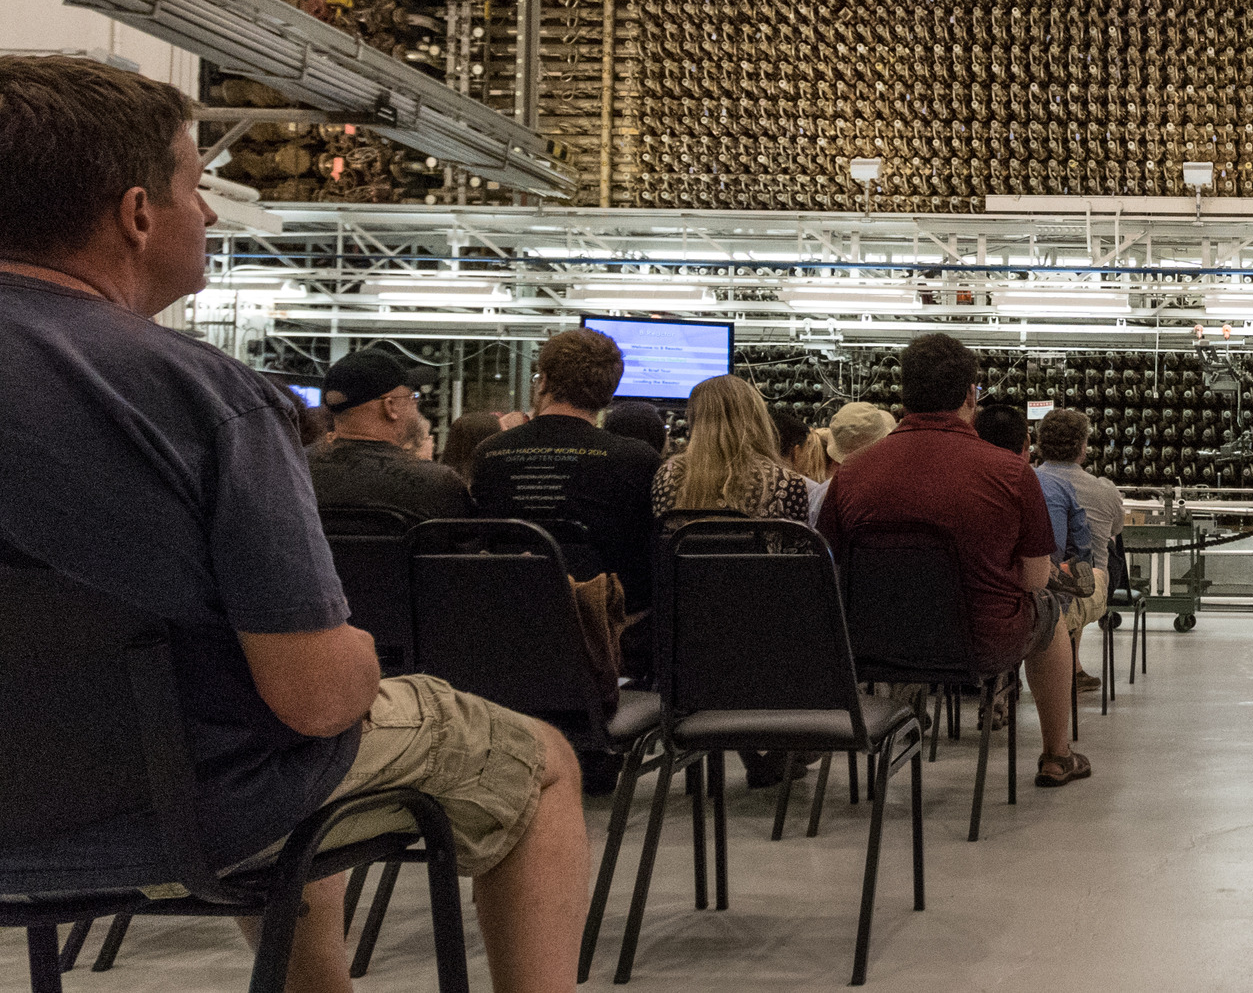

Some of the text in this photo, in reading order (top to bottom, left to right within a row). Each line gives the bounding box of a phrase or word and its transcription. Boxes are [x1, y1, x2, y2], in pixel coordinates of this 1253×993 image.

[516, 447, 553, 455] HADOOP
[554, 447, 586, 455] WORLD
[587, 448, 608, 457] 2014
